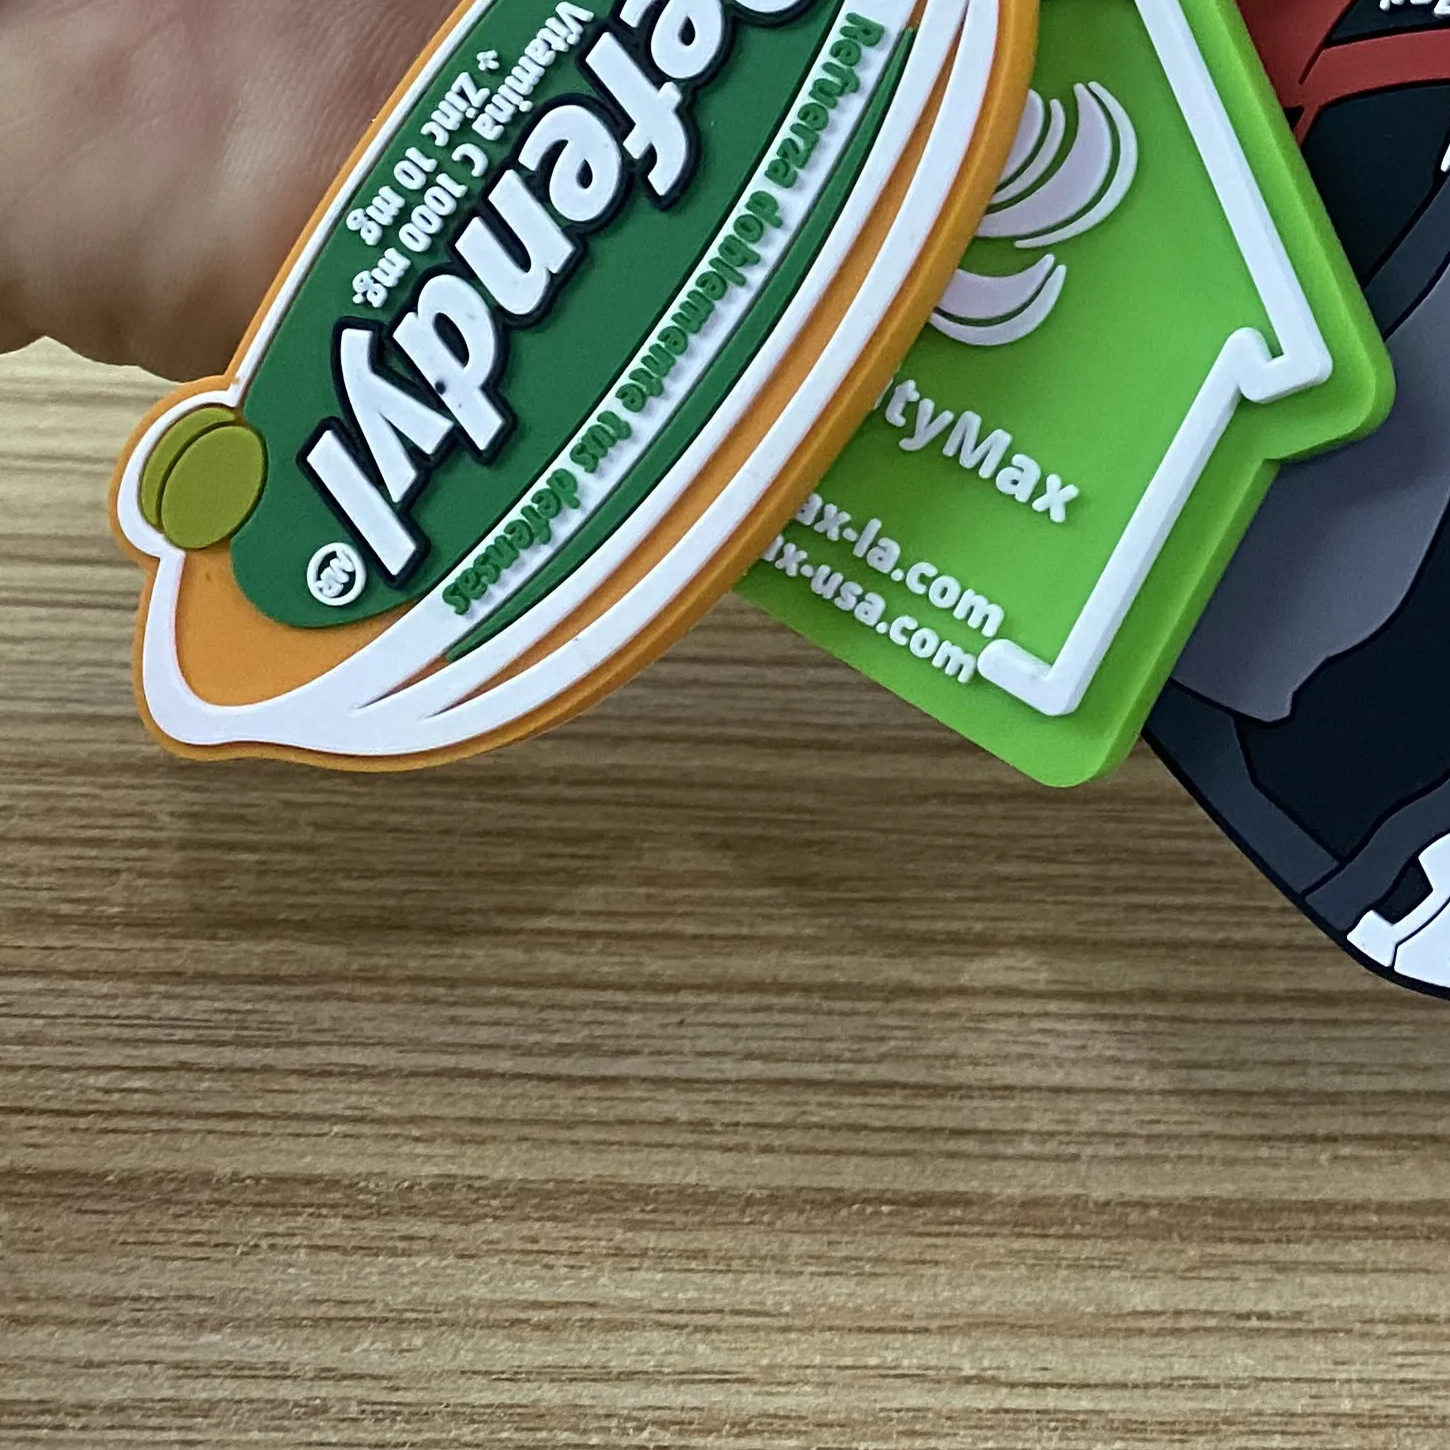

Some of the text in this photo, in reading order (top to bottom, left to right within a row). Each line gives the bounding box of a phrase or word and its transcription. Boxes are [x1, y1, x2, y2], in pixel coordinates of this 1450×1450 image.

[420, 72, 491, 147] Zinc
[471, 1, 594, 141] Vitamina
[393, 147, 438, 190] 10
[451, 143, 489, 177] C
[346, 186, 405, 246] mg
[398, 173, 469, 252] 1000
[442, 12, 886, 616] Refuerza doblemente tus defensas
[874, 375, 1080, 524] tyMax
